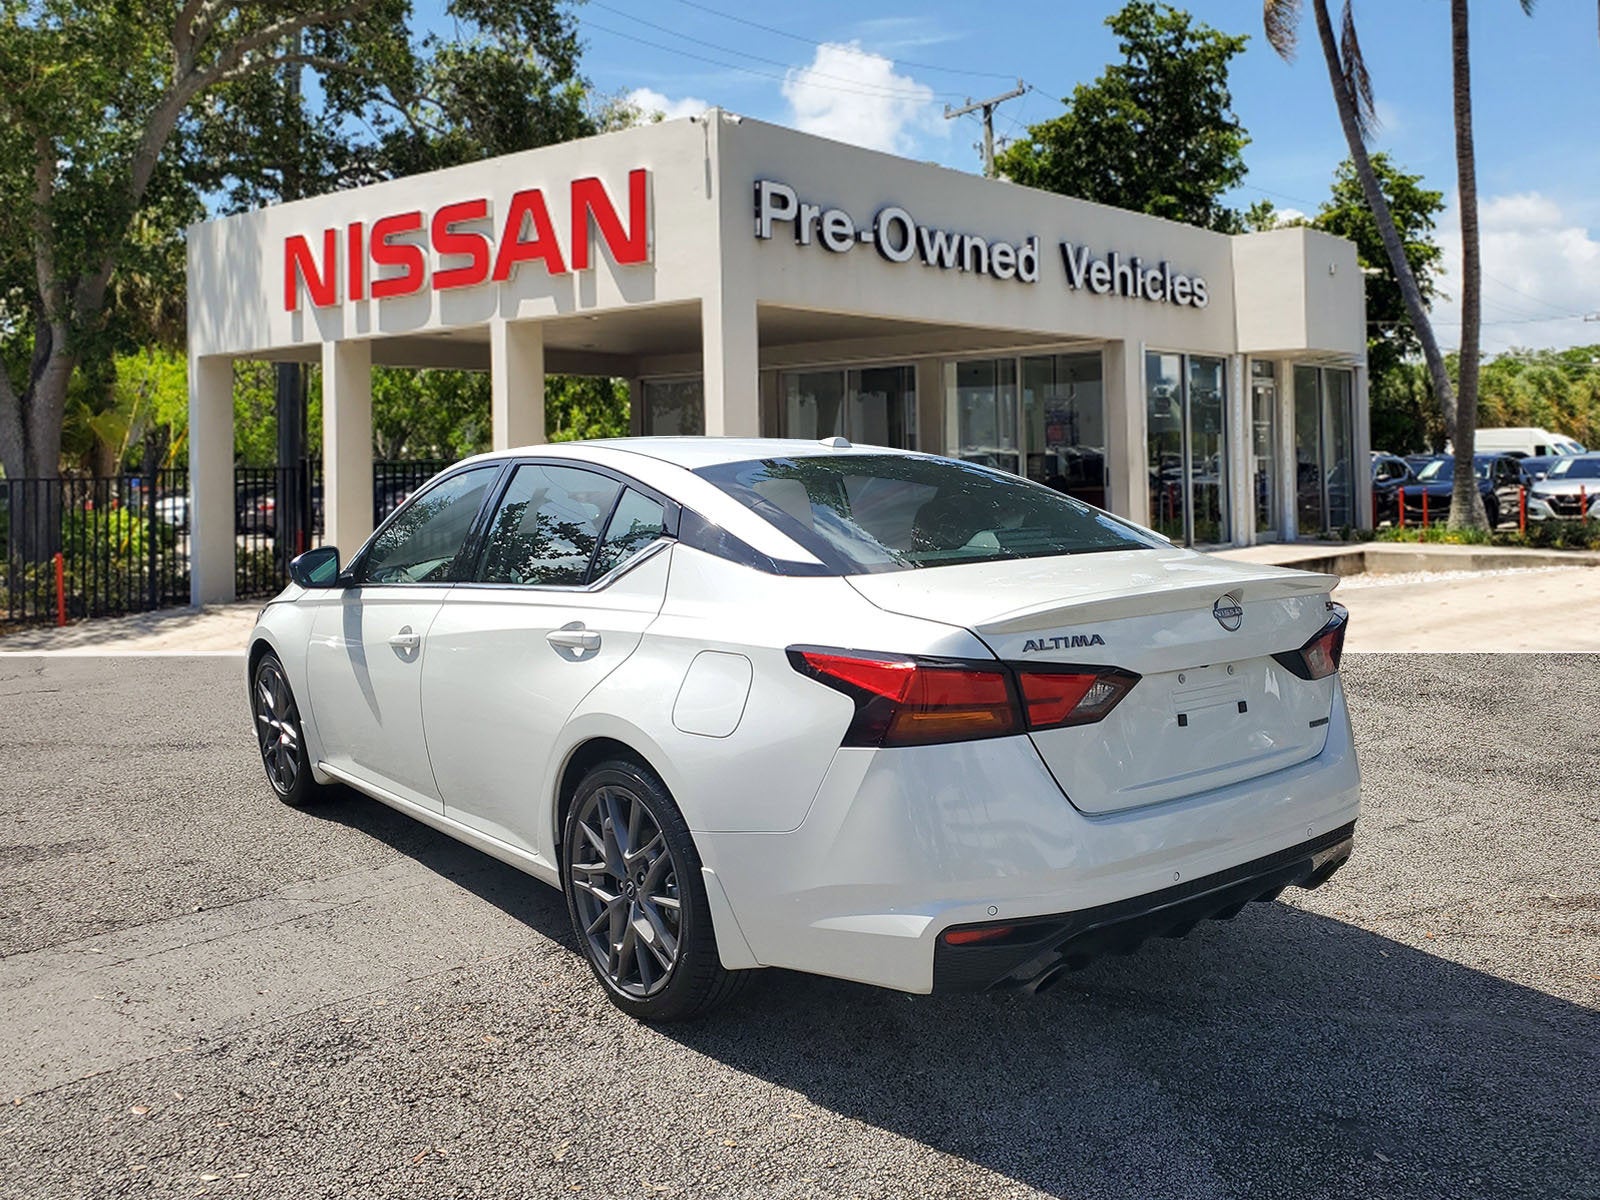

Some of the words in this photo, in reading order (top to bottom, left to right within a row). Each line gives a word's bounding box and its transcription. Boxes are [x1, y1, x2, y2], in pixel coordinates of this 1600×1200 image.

[284, 168, 648, 312] NISSAN
[754, 179, 1039, 283] Pre-Owned
[1060, 241, 1209, 309] Vehicles
[1022, 633, 1105, 652] ALTIMA
